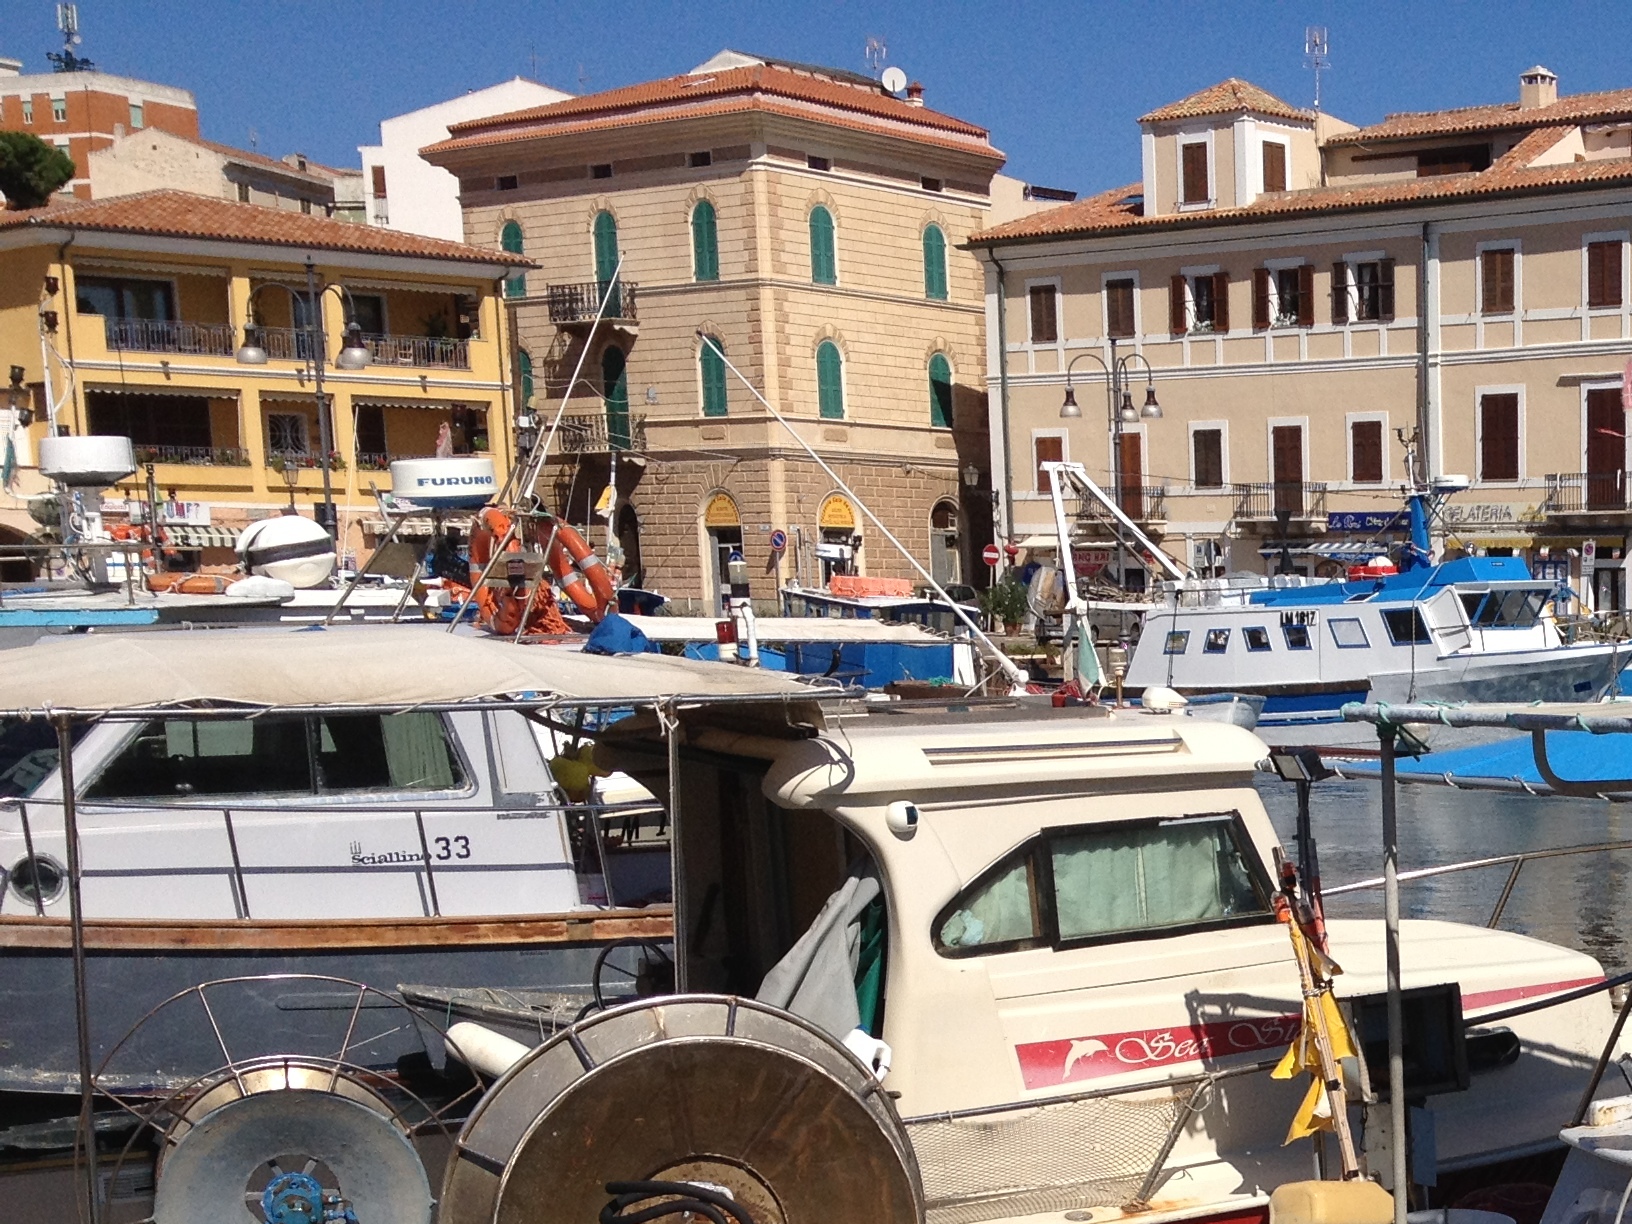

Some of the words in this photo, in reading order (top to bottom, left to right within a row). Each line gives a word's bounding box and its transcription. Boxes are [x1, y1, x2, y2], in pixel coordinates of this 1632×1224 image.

[416, 475, 493, 487] FURUNO
[1444, 504, 1513, 522] GELATERIA
[435, 835, 471, 861] 33
[1115, 1030, 1213, 1064] Sea
